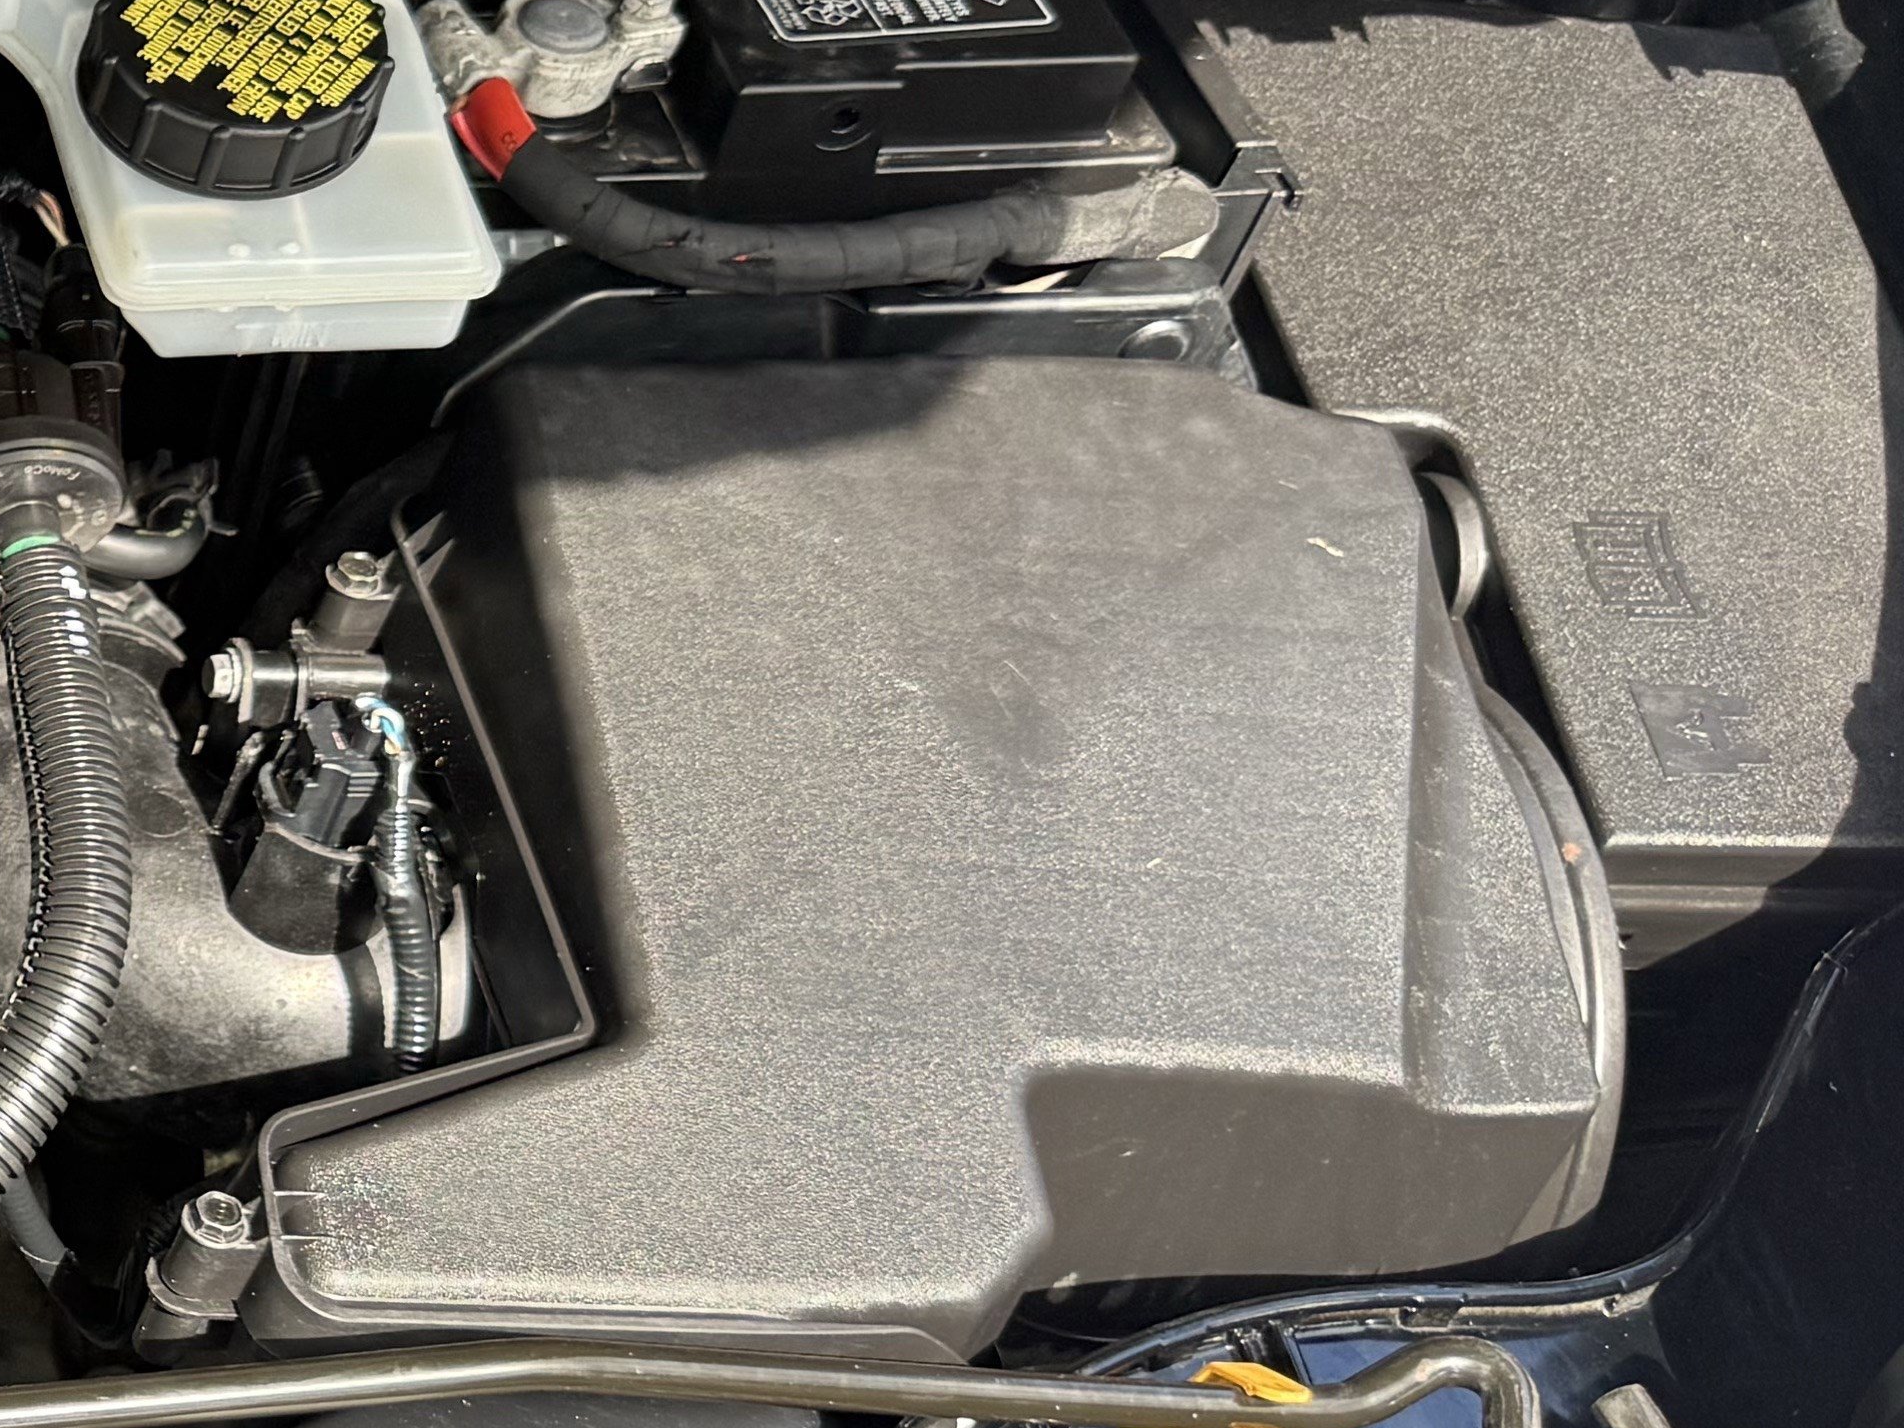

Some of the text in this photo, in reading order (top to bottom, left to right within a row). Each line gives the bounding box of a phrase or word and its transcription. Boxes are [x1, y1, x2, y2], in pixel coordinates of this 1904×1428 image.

[177, 0, 205, 22] DU
[224, 9, 250, 30] LE
[299, 13, 331, 41] DOT
[136, 18, 187, 64] LIQUIDE
[174, 28, 232, 83] BOUCHON
[288, 37, 309, 50] 4
[216, 33, 284, 94] CONTAINER.
[248, 0, 374, 124] BEFORE REMOVING. USE
[258, 47, 299, 82] FLUID
[282, 22, 380, 121] CLEAN FILLER CAP
[315, 56, 376, 108] WARNING:
[226, 79, 270, 116] FROM
